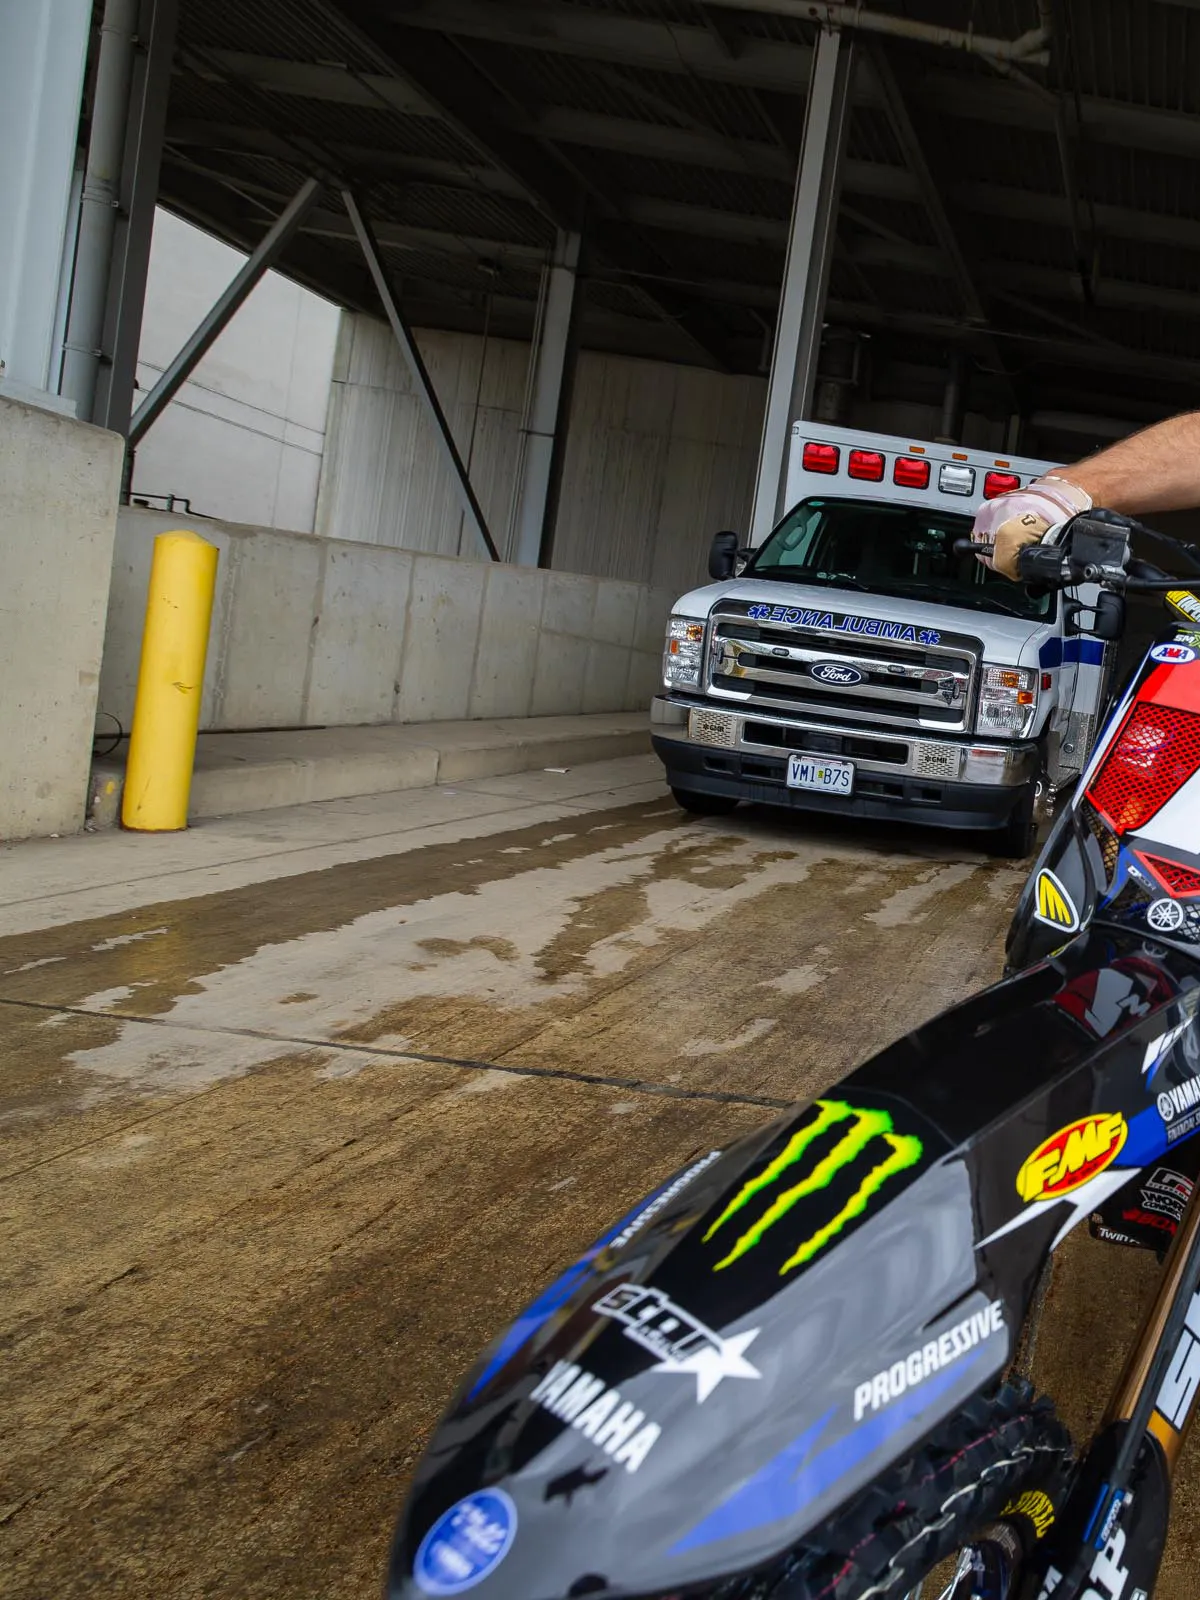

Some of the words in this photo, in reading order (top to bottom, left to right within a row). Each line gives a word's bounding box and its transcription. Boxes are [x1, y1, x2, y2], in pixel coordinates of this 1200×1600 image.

[820, 665, 853, 683] Ford
[1156, 647, 1189, 664] AMA
[792, 763, 816, 783] VM1
[823, 767, 850, 787] B7S
[1023, 1111, 1123, 1203] FMF
[853, 1301, 1005, 1421] PROGRESSIVE
[530, 1361, 662, 1474] YAMAHA
